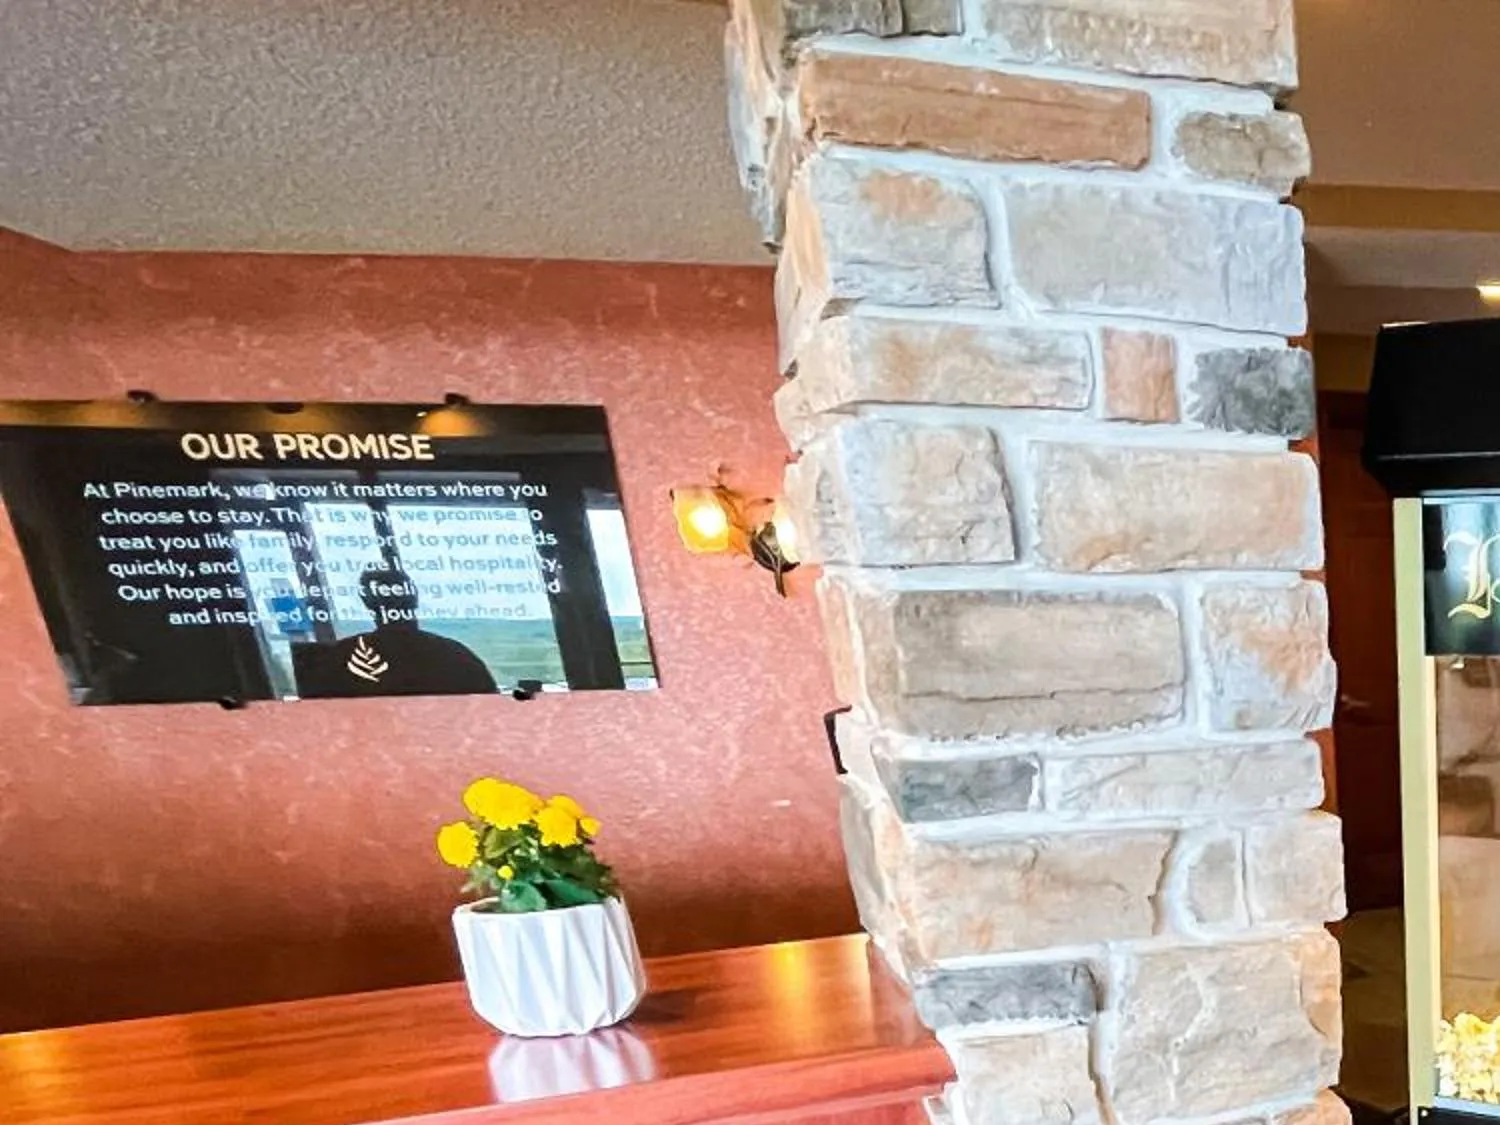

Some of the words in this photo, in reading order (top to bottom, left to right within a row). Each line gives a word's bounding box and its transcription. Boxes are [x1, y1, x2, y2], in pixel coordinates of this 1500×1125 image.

[181, 433, 264, 460] OUR
[273, 433, 435, 460] PROMISE
[83, 482, 111, 498] At
[114, 481, 231, 500] Pinemark,
[234, 483, 267, 498] we
[269, 481, 328, 499] know
[333, 481, 348, 498] it
[353, 481, 437, 498] matters
[442, 481, 504, 498] where
[509, 485, 548, 500] you
[101, 508, 184, 525] choose
[189, 509, 212, 524] to
[217, 509, 271, 526] stay.
[269, 507, 324, 523] That
[329, 509, 347, 522] is
[399, 509, 428, 521] we
[433, 508, 517, 525] promise
[100, 534, 155, 550] treat
[158, 537, 200, 553] you
[204, 533, 242, 549] like
[325, 531, 412, 548] respond
[418, 532, 439, 546] to
[443, 534, 489, 549] your
[495, 530, 558, 546] needs
[108, 558, 195, 578] quickly,
[199, 559, 240, 575] and
[301, 561, 340, 577] you
[393, 556, 443, 572] local
[118, 584, 160, 600] Our
[165, 584, 222, 601] hope
[226, 584, 246, 599] is
[369, 580, 443, 599] feeling
[169, 609, 211, 625] and
[214, 608, 302, 628] insped
